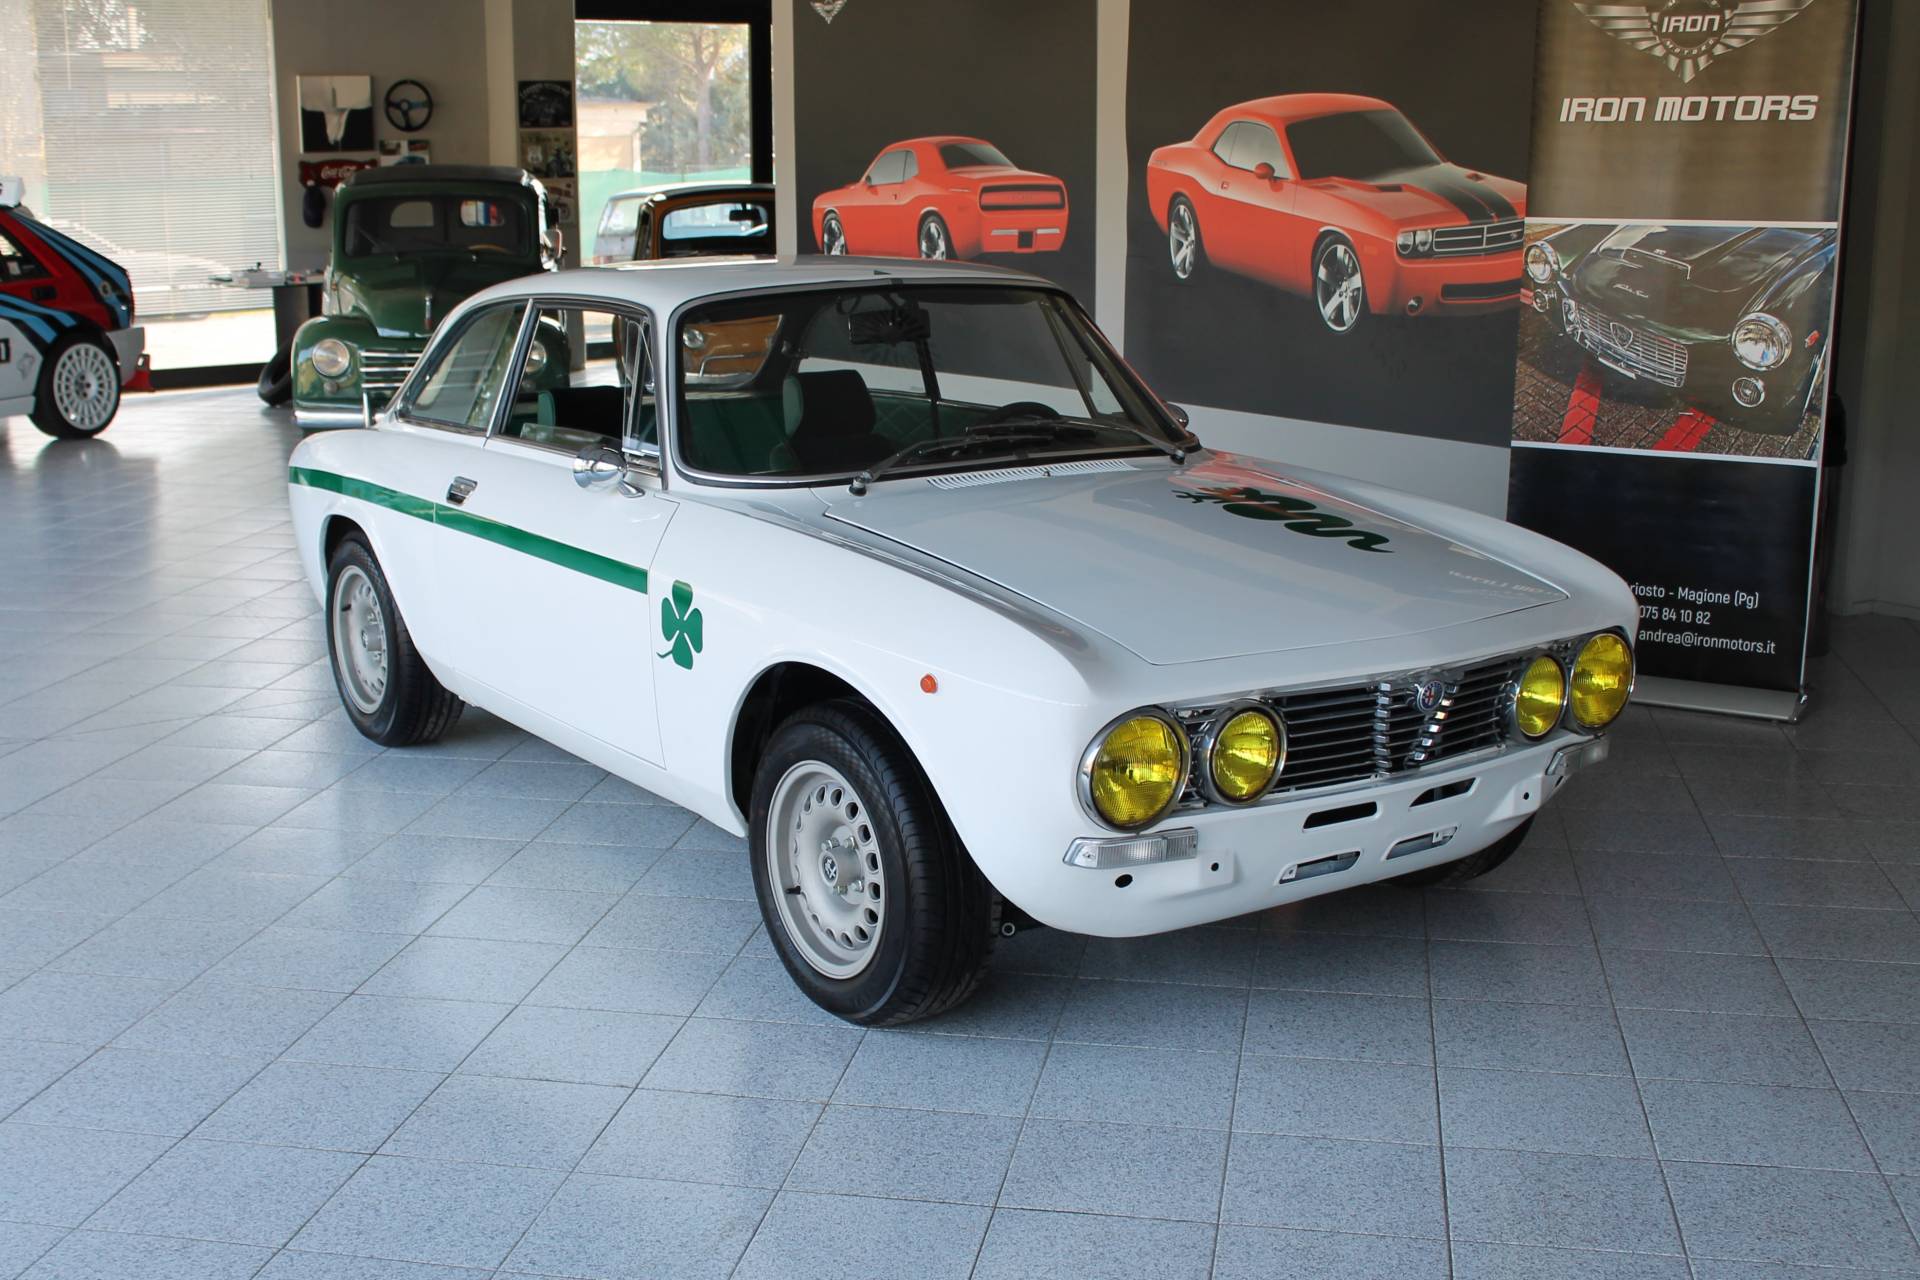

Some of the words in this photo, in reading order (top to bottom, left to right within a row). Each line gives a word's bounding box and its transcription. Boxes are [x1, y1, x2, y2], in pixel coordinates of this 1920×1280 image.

[1661, 14, 1720, 33] IRON
[1559, 97, 1646, 122] IRON
[1654, 95, 1819, 121] MOTORS
[1677, 587, 1730, 605] Magione
[1734, 590, 1759, 609] (Pg)
[1662, 607, 1676, 621] 84
[1680, 609, 1692, 623] 10
[1696, 611, 1711, 625] 82
[1638, 628, 1776, 654] andrea@ironmotors.it
